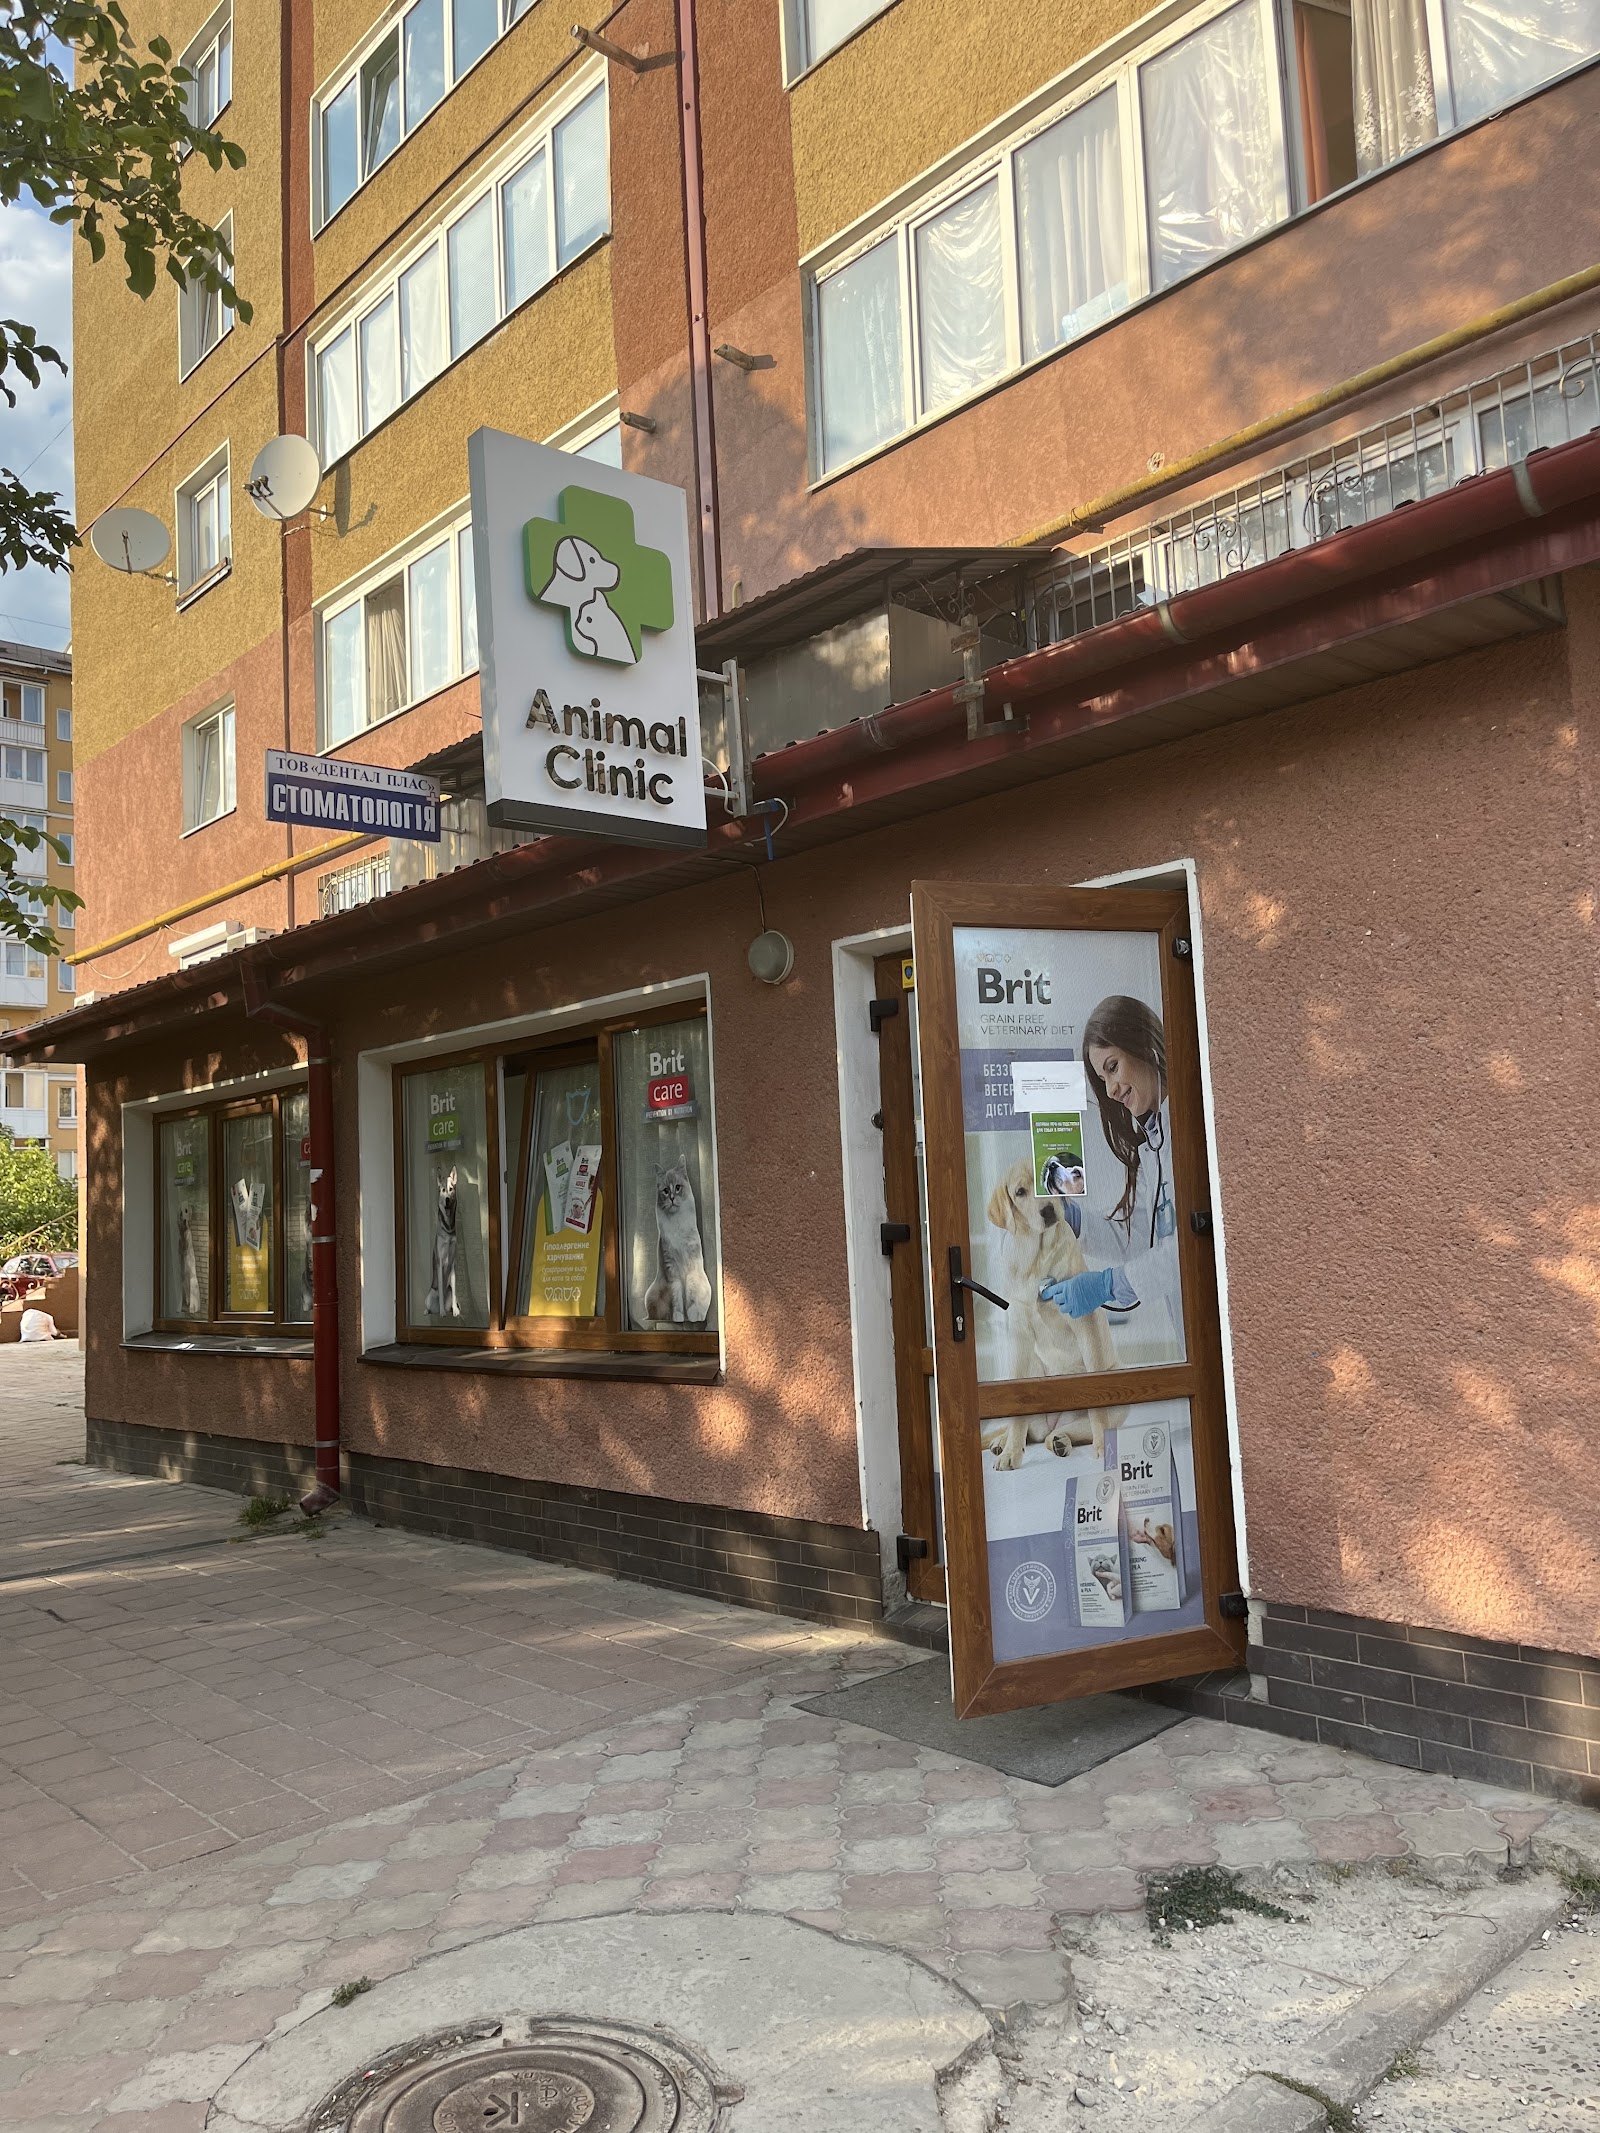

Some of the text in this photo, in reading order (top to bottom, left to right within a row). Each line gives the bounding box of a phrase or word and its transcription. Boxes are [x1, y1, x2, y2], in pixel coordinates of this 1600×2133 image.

[526, 688, 687, 757] Animal
[276, 757, 435, 792] ТОВ «ДЕНТАЛ ПЛАС»
[546, 745, 674, 805] Clinic
[273, 784, 436, 833] СТОМАТОЛОГІЯ
[977, 967, 1052, 1005] Brit
[981, 1014, 1045, 1024] GRAIN FREE
[981, 1026, 1075, 1035] VETERINARY DIET
[650, 1049, 685, 1076] Brit
[983, 1063, 1013, 1077] БЕЗЗ
[654, 1083, 683, 1101] care
[985, 1083, 1014, 1096] ВЕТЕР
[431, 1092, 455, 1114] Brit
[433, 1120, 454, 1136] care
[176, 1141, 192, 1156] Brit
[178, 1162, 191, 1173] care
[1121, 1460, 1153, 1482] Brit
[1077, 1506, 1102, 1524] Brit
